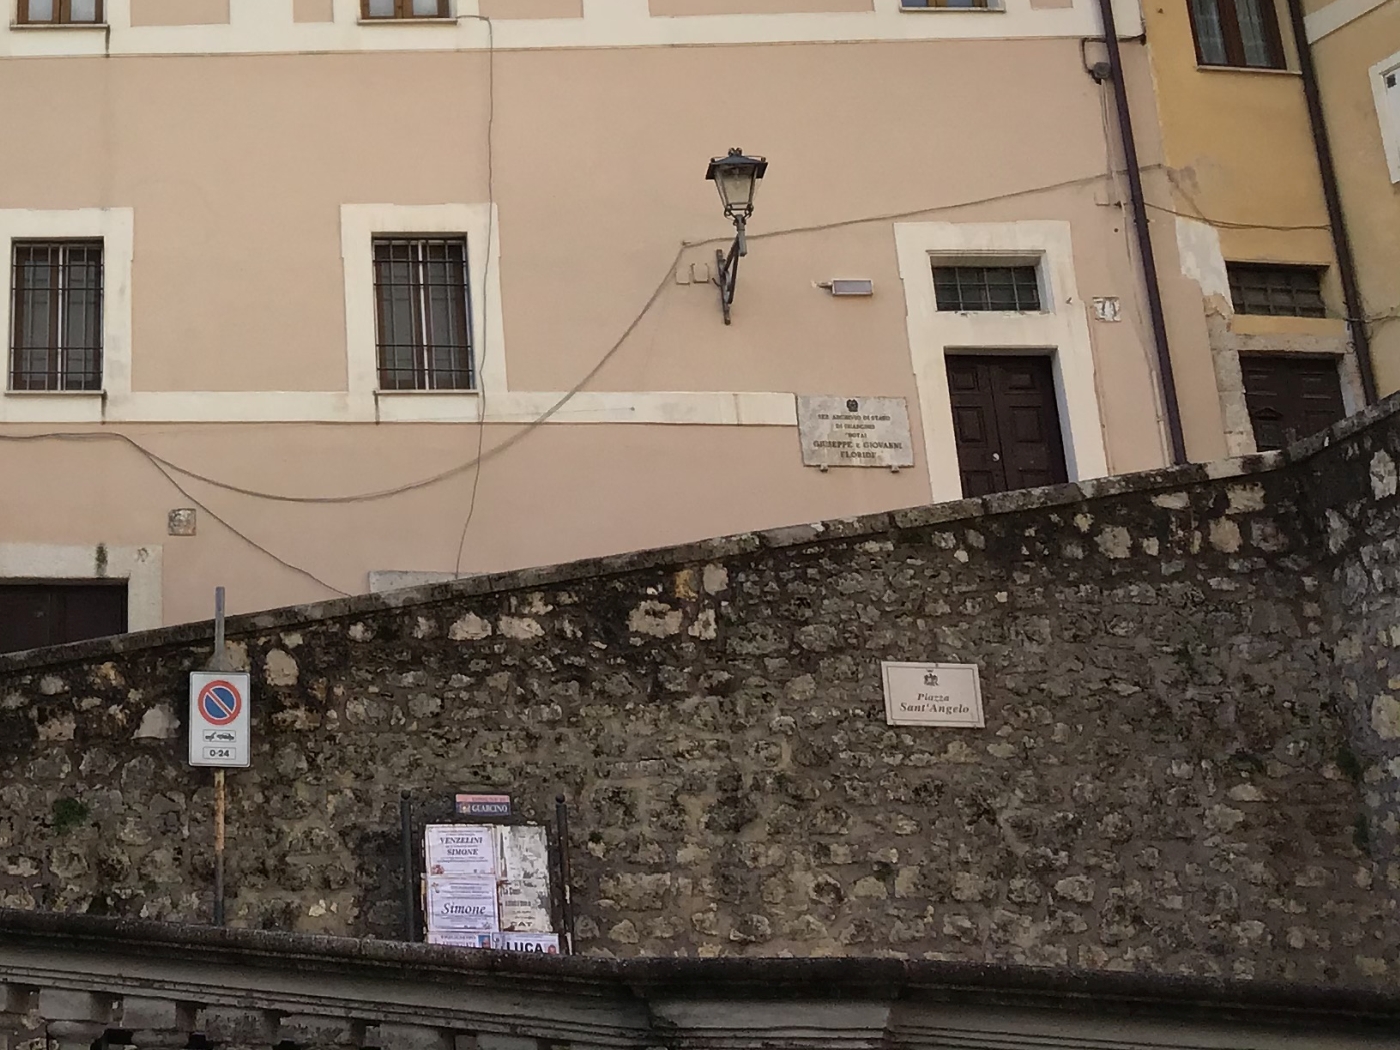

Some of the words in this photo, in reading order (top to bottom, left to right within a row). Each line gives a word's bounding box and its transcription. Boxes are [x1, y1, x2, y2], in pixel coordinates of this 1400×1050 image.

[863, 441, 903, 449] GIOVANNI
[916, 692, 950, 702] Piazza
[900, 702, 970, 715] Sant'Angelo
[472, 804, 508, 812] GUARCINO
[440, 836, 483, 844] VENZELINI
[446, 848, 479, 856] SIMONE
[440, 901, 486, 915] Simone
